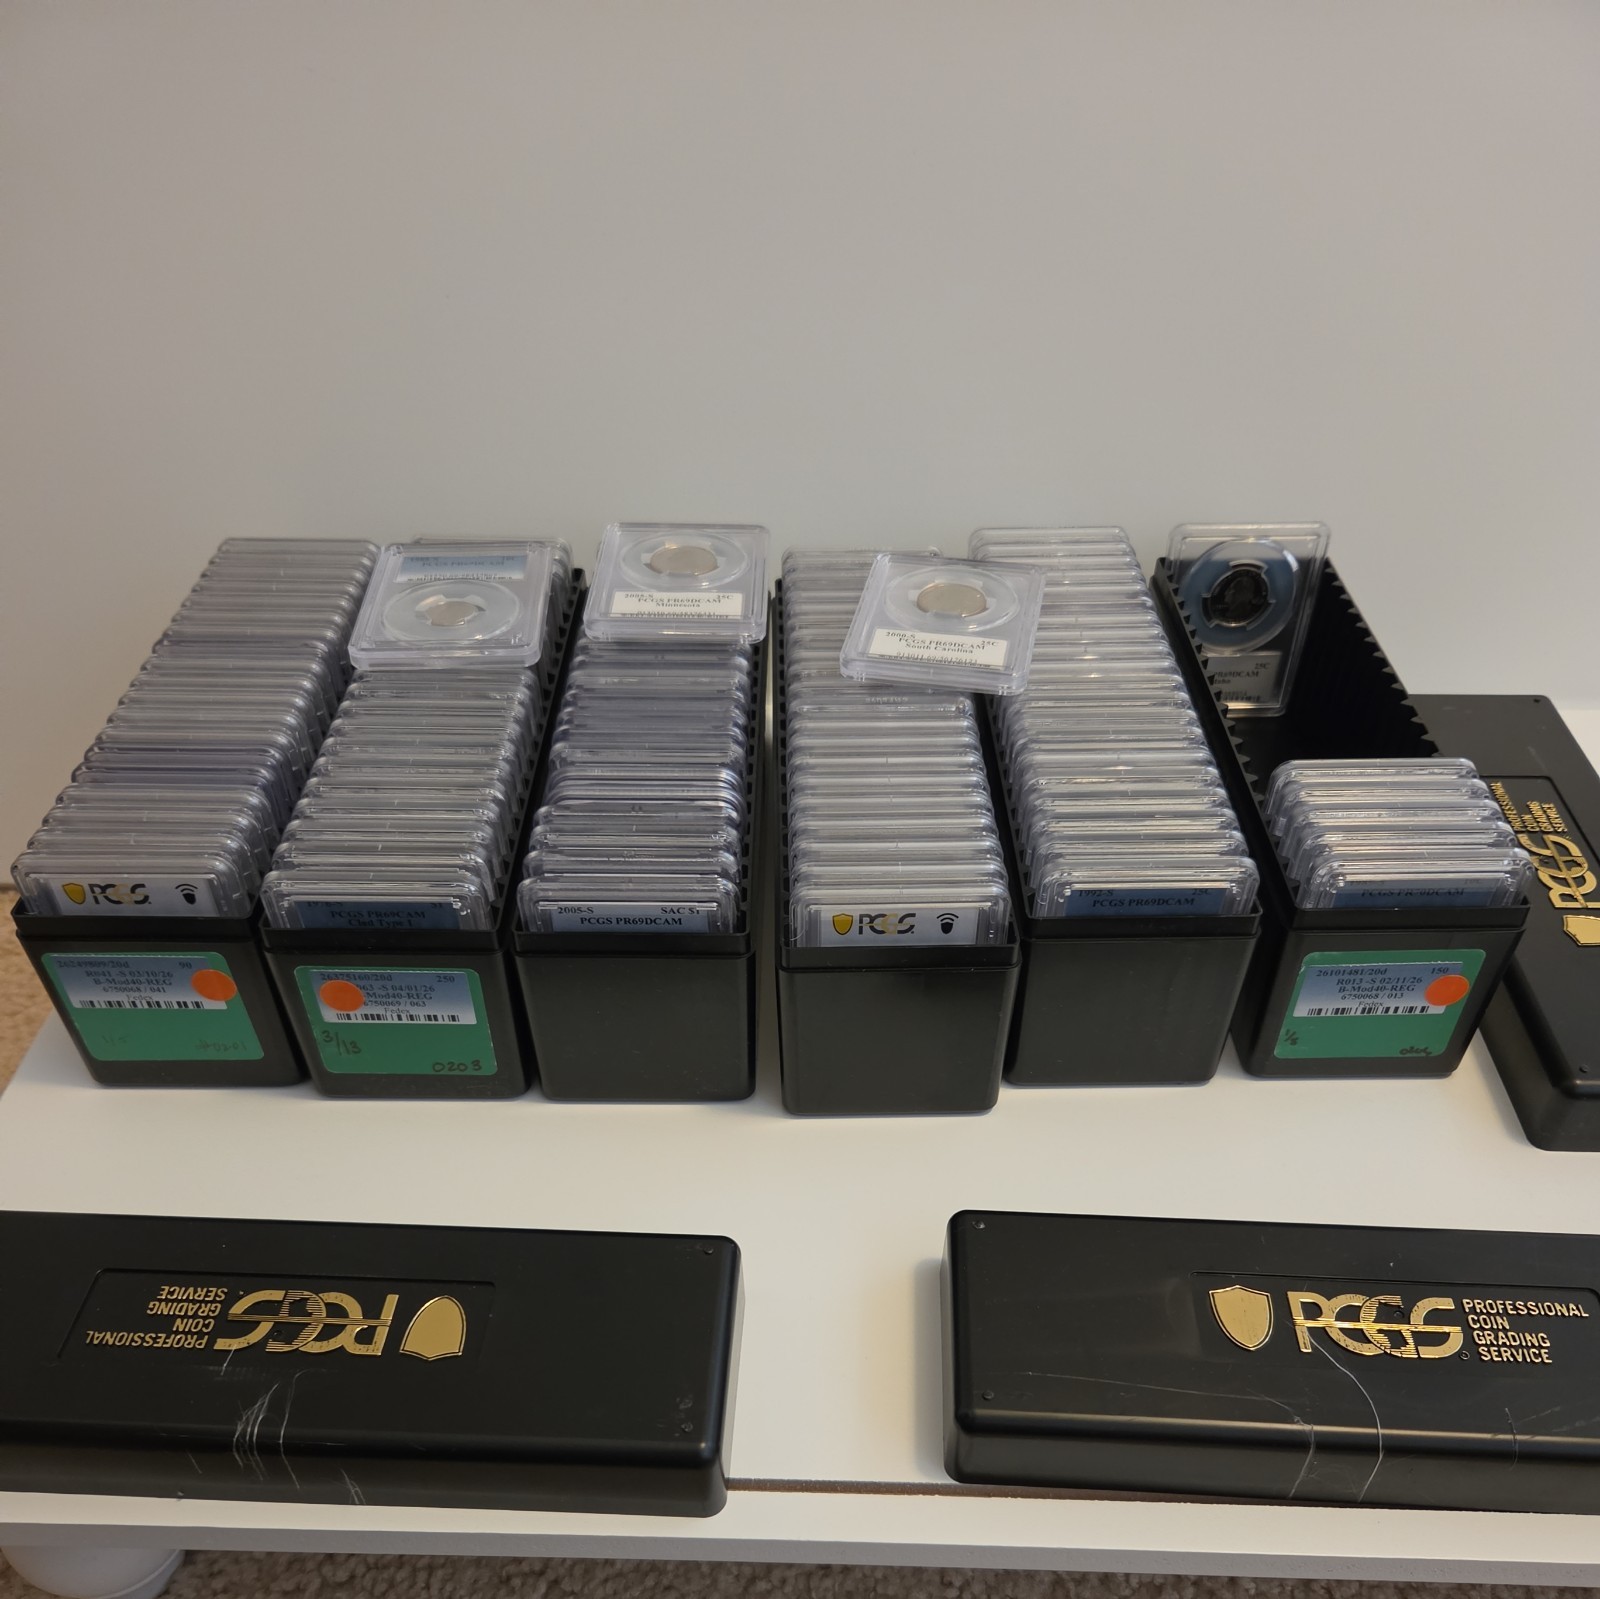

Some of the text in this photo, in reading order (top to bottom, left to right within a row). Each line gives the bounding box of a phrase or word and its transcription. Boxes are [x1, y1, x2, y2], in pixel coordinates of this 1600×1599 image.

[898, 637, 986, 650] PCGS PR69DCAM
[905, 643, 974, 654] South Carolina
[1520, 814, 1540, 832] COIN
[1527, 801, 1554, 832] GRADING
[1542, 802, 1568, 832] SERVICE
[88, 883, 152, 905] PCGS
[1092, 898, 1195, 908] PCGS PR69DCAM
[330, 911, 365, 919] PCGS
[558, 906, 594, 915] 2005-S
[660, 907, 686, 915] SAC
[349, 919, 376, 927] Clad
[378, 919, 404, 929] Type
[580, 917, 683, 925] PCGS PR69DCAM
[858, 913, 917, 935] PCGS
[1316, 966, 1450, 977] 26101481/20d 150
[94, 978, 172, 986] B-Mod40-REG
[436, 975, 455, 983] 250
[1336, 978, 1362, 986] R013
[1379, 976, 1423, 985] 02/11/26
[391, 985, 435, 993] 04/01/26
[1338, 984, 1415, 993] B-Mod40-REG
[364, 992, 433, 1000] -Mod40-REG
[363, 1000, 402, 1008] 6750069
[410, 1000, 427, 1008] 063
[321, 1029, 362, 1056] 3/13
[432, 1060, 483, 1073] 0203
[157, 1285, 228, 1301] SERVICE
[146, 1301, 222, 1317] GRADING
[1462, 1299, 1589, 1318] PROFESSIONAL
[173, 1317, 215, 1332] COIN
[213, 1289, 400, 1356] PCGS
[1287, 1291, 1464, 1359] PCGS
[1467, 1314, 1509, 1329] COIN
[86, 1330, 208, 1349] PROFESSIONAL
[1473, 1331, 1551, 1348] GRADING
[1479, 1347, 1553, 1364] SERVICE
